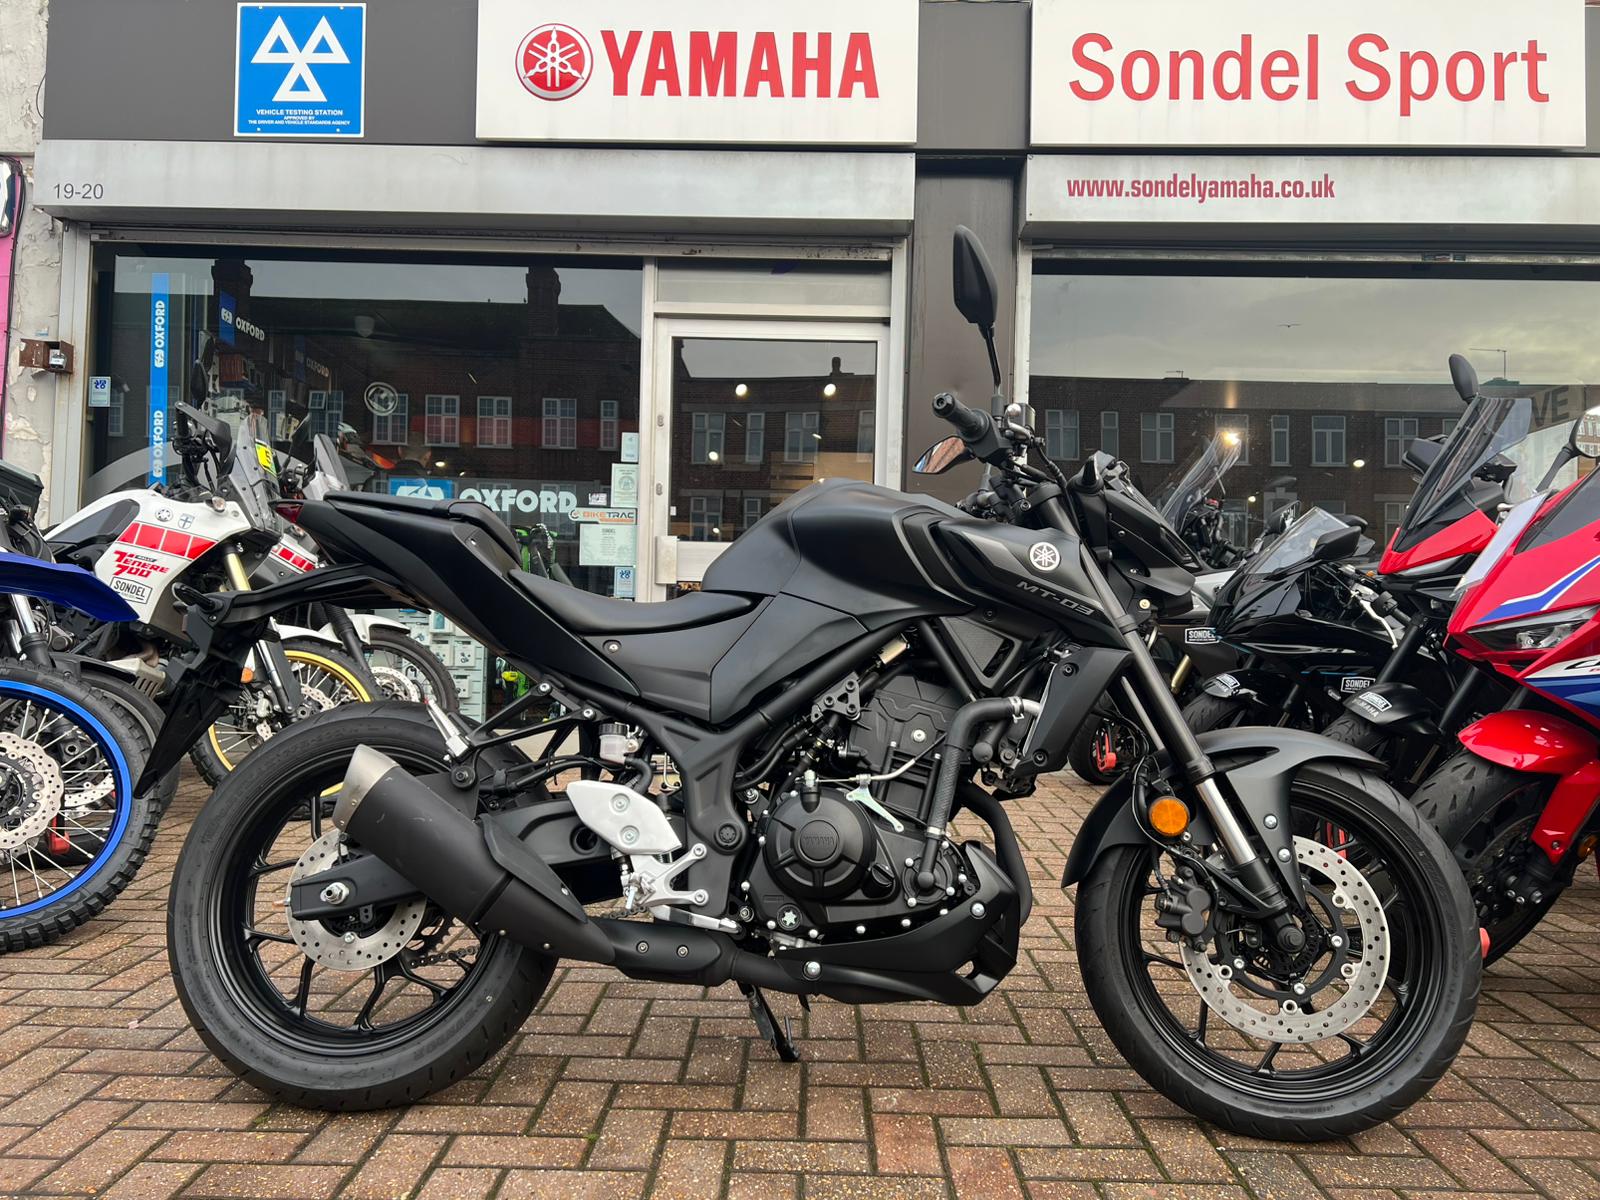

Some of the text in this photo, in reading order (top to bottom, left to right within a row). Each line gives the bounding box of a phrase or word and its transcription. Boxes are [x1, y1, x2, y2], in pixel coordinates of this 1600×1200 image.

[600, 30, 880, 98] YAMAHA
[1068, 32, 1550, 117] Sondel Sport
[53, 183, 104, 200] 19-20
[1067, 173, 1335, 203] www.sondelyamaha.co.uk
[155, 300, 165, 348] OXFORD
[235, 316, 265, 341] OXFORD
[153, 410, 163, 458] OXFORD
[459, 488, 577, 513] OXFORD
[582, 511, 635, 519] BIKETRAC
[112, 563, 153, 578] 700
[113, 580, 146, 598] SONDEL
[1016, 581, 1095, 616] MT-03
